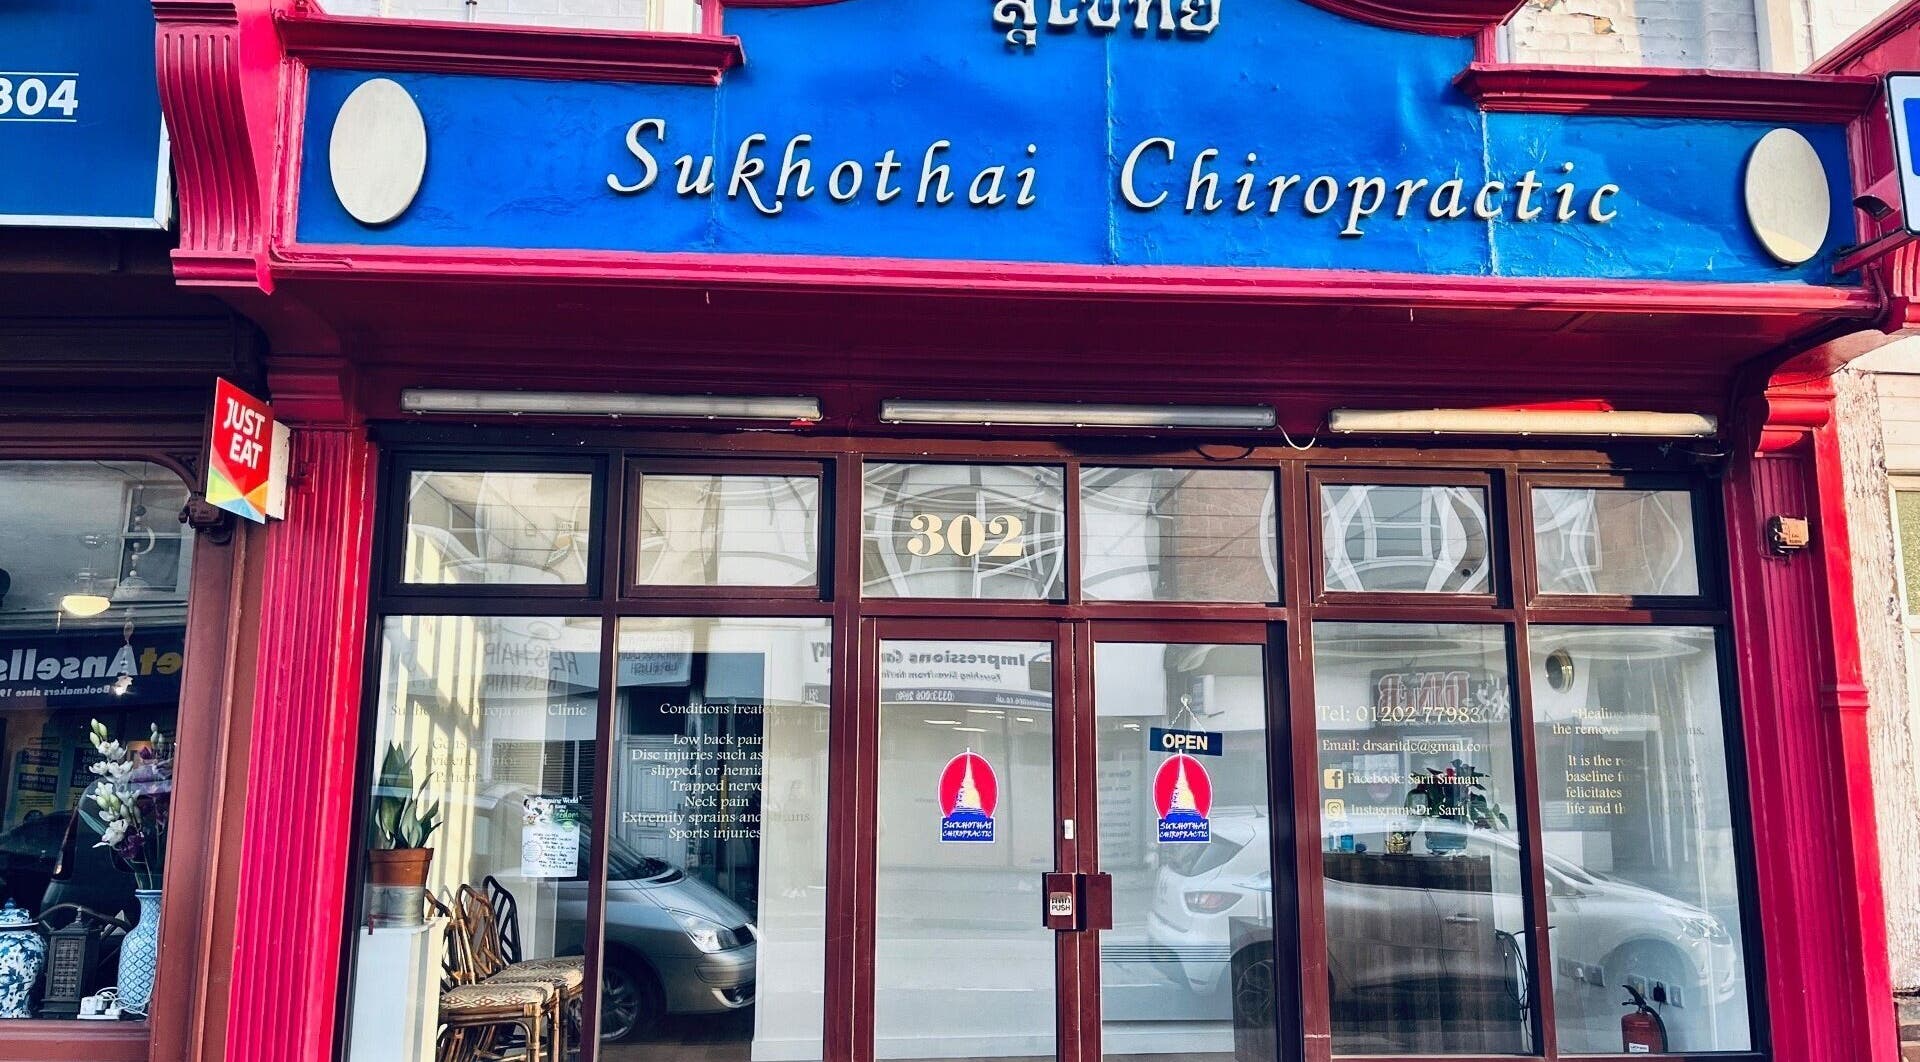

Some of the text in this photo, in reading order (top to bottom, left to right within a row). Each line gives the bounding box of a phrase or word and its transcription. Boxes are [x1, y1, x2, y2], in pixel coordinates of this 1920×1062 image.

[606, 117, 1620, 236] Sukhothai Chiropractic
[223, 396, 266, 440] JUST
[229, 432, 263, 470] EAT
[906, 512, 1024, 558] 302
[547, 703, 587, 716] Clinic
[660, 703, 730, 714] Conditions
[1318, 705, 1351, 721] Tel:
[1356, 706, 1416, 721] 01202
[1553, 723, 1622, 735] the remova
[673, 734, 701, 745] Low
[704, 733, 734, 745] back
[1162, 733, 1208, 751] OPEN
[1322, 739, 1360, 751] Email:
[632, 749, 661, 760] Disc
[664, 749, 714, 763] injuries
[716, 749, 747, 761] such
[1568, 754, 1577, 766] It
[1581, 754, 1590, 766] is
[1593, 754, 1613, 766] the
[651, 765, 765, 779] slipped, or hernia
[1565, 770, 1615, 782] baseline
[1347, 773, 1404, 785] Facebook:
[1408, 773, 1434, 785] Sarit
[670, 780, 725, 795] Trapped
[1566, 786, 1623, 798] felicitates
[684, 796, 750, 810] Neck pain
[1566, 802, 1585, 814] life
[1588, 802, 1611, 814] and
[622, 811, 686, 826] Extremity
[688, 811, 736, 826] sprains
[943, 821, 992, 829] SUKHOTHAI
[1159, 822, 1208, 830] SUKHOTHAI
[668, 827, 763, 842] Sports injuries
[943, 830, 993, 838] CHIROPRACTIC
[1159, 831, 1209, 839] CHIROPRACTIC
